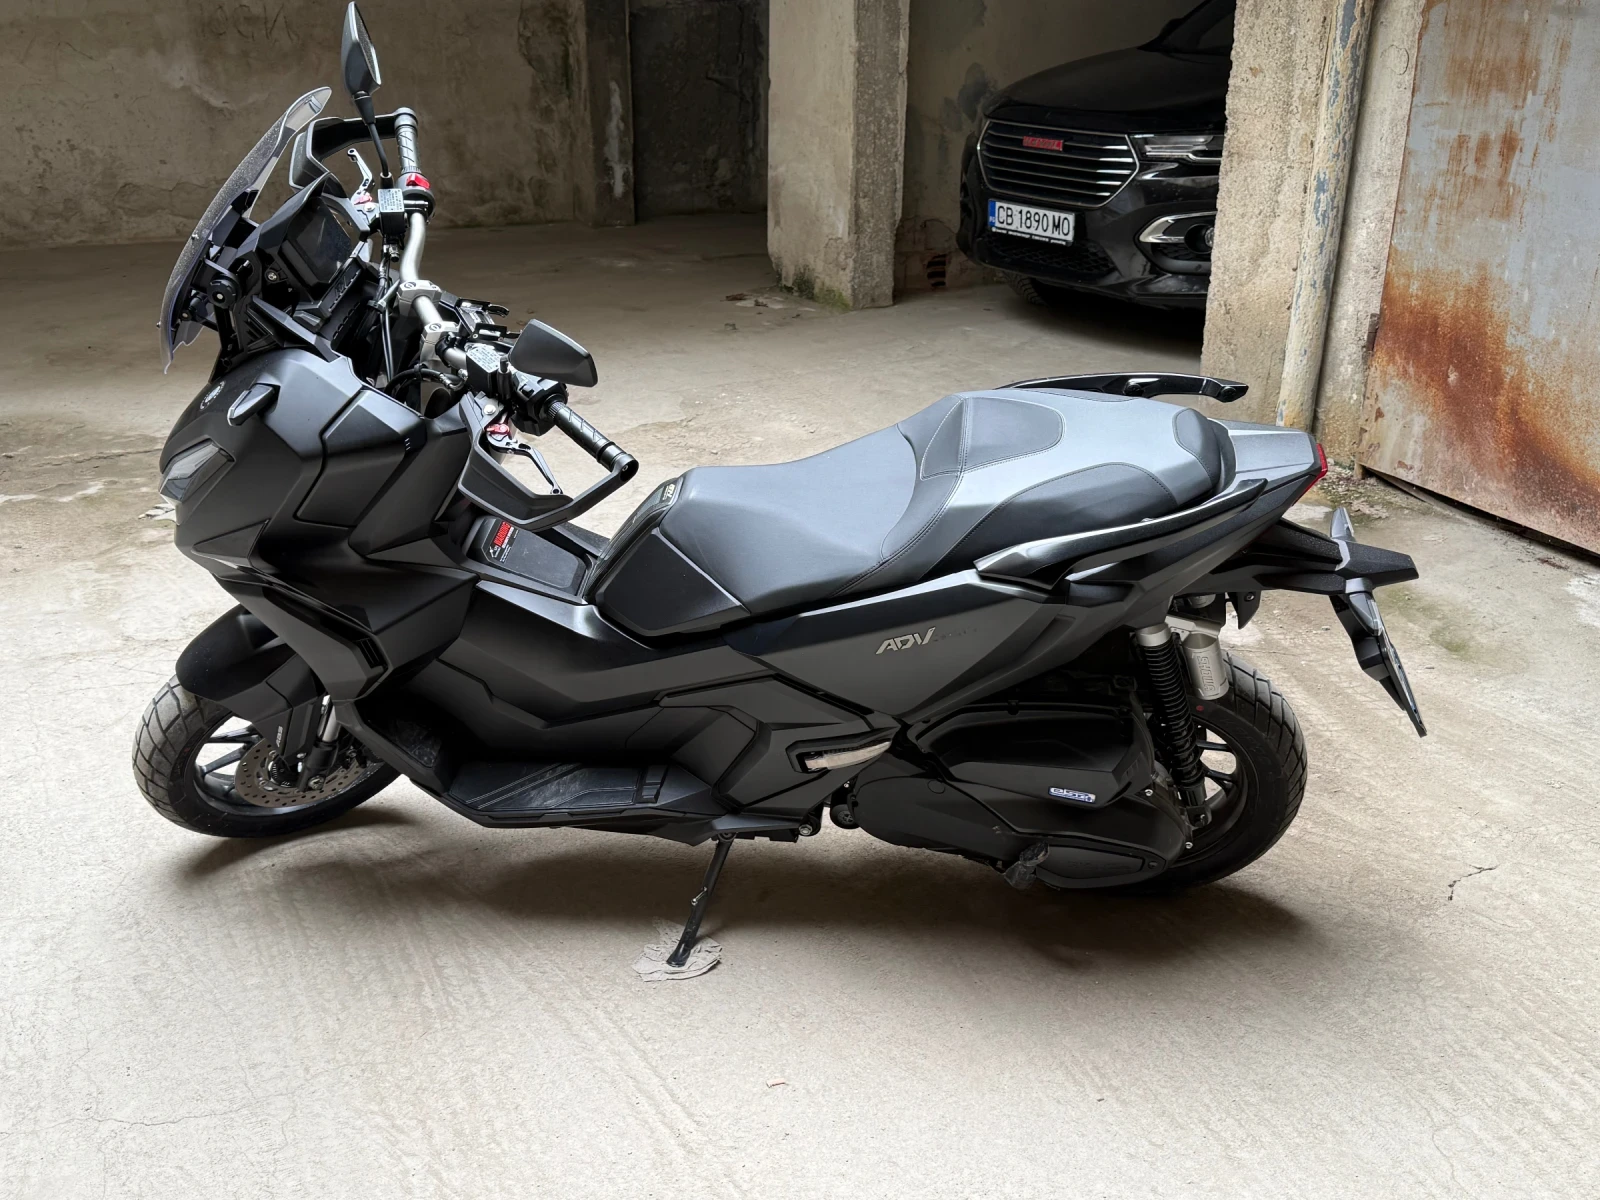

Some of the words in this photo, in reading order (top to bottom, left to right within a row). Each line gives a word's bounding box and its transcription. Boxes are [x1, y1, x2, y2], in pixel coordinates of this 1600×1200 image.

[997, 205, 1014, 226] CB
[1018, 209, 1050, 230] 1890
[1052, 216, 1071, 236] MO
[876, 626, 936, 654] ADV
[1196, 655, 1216, 692] SHOWA
